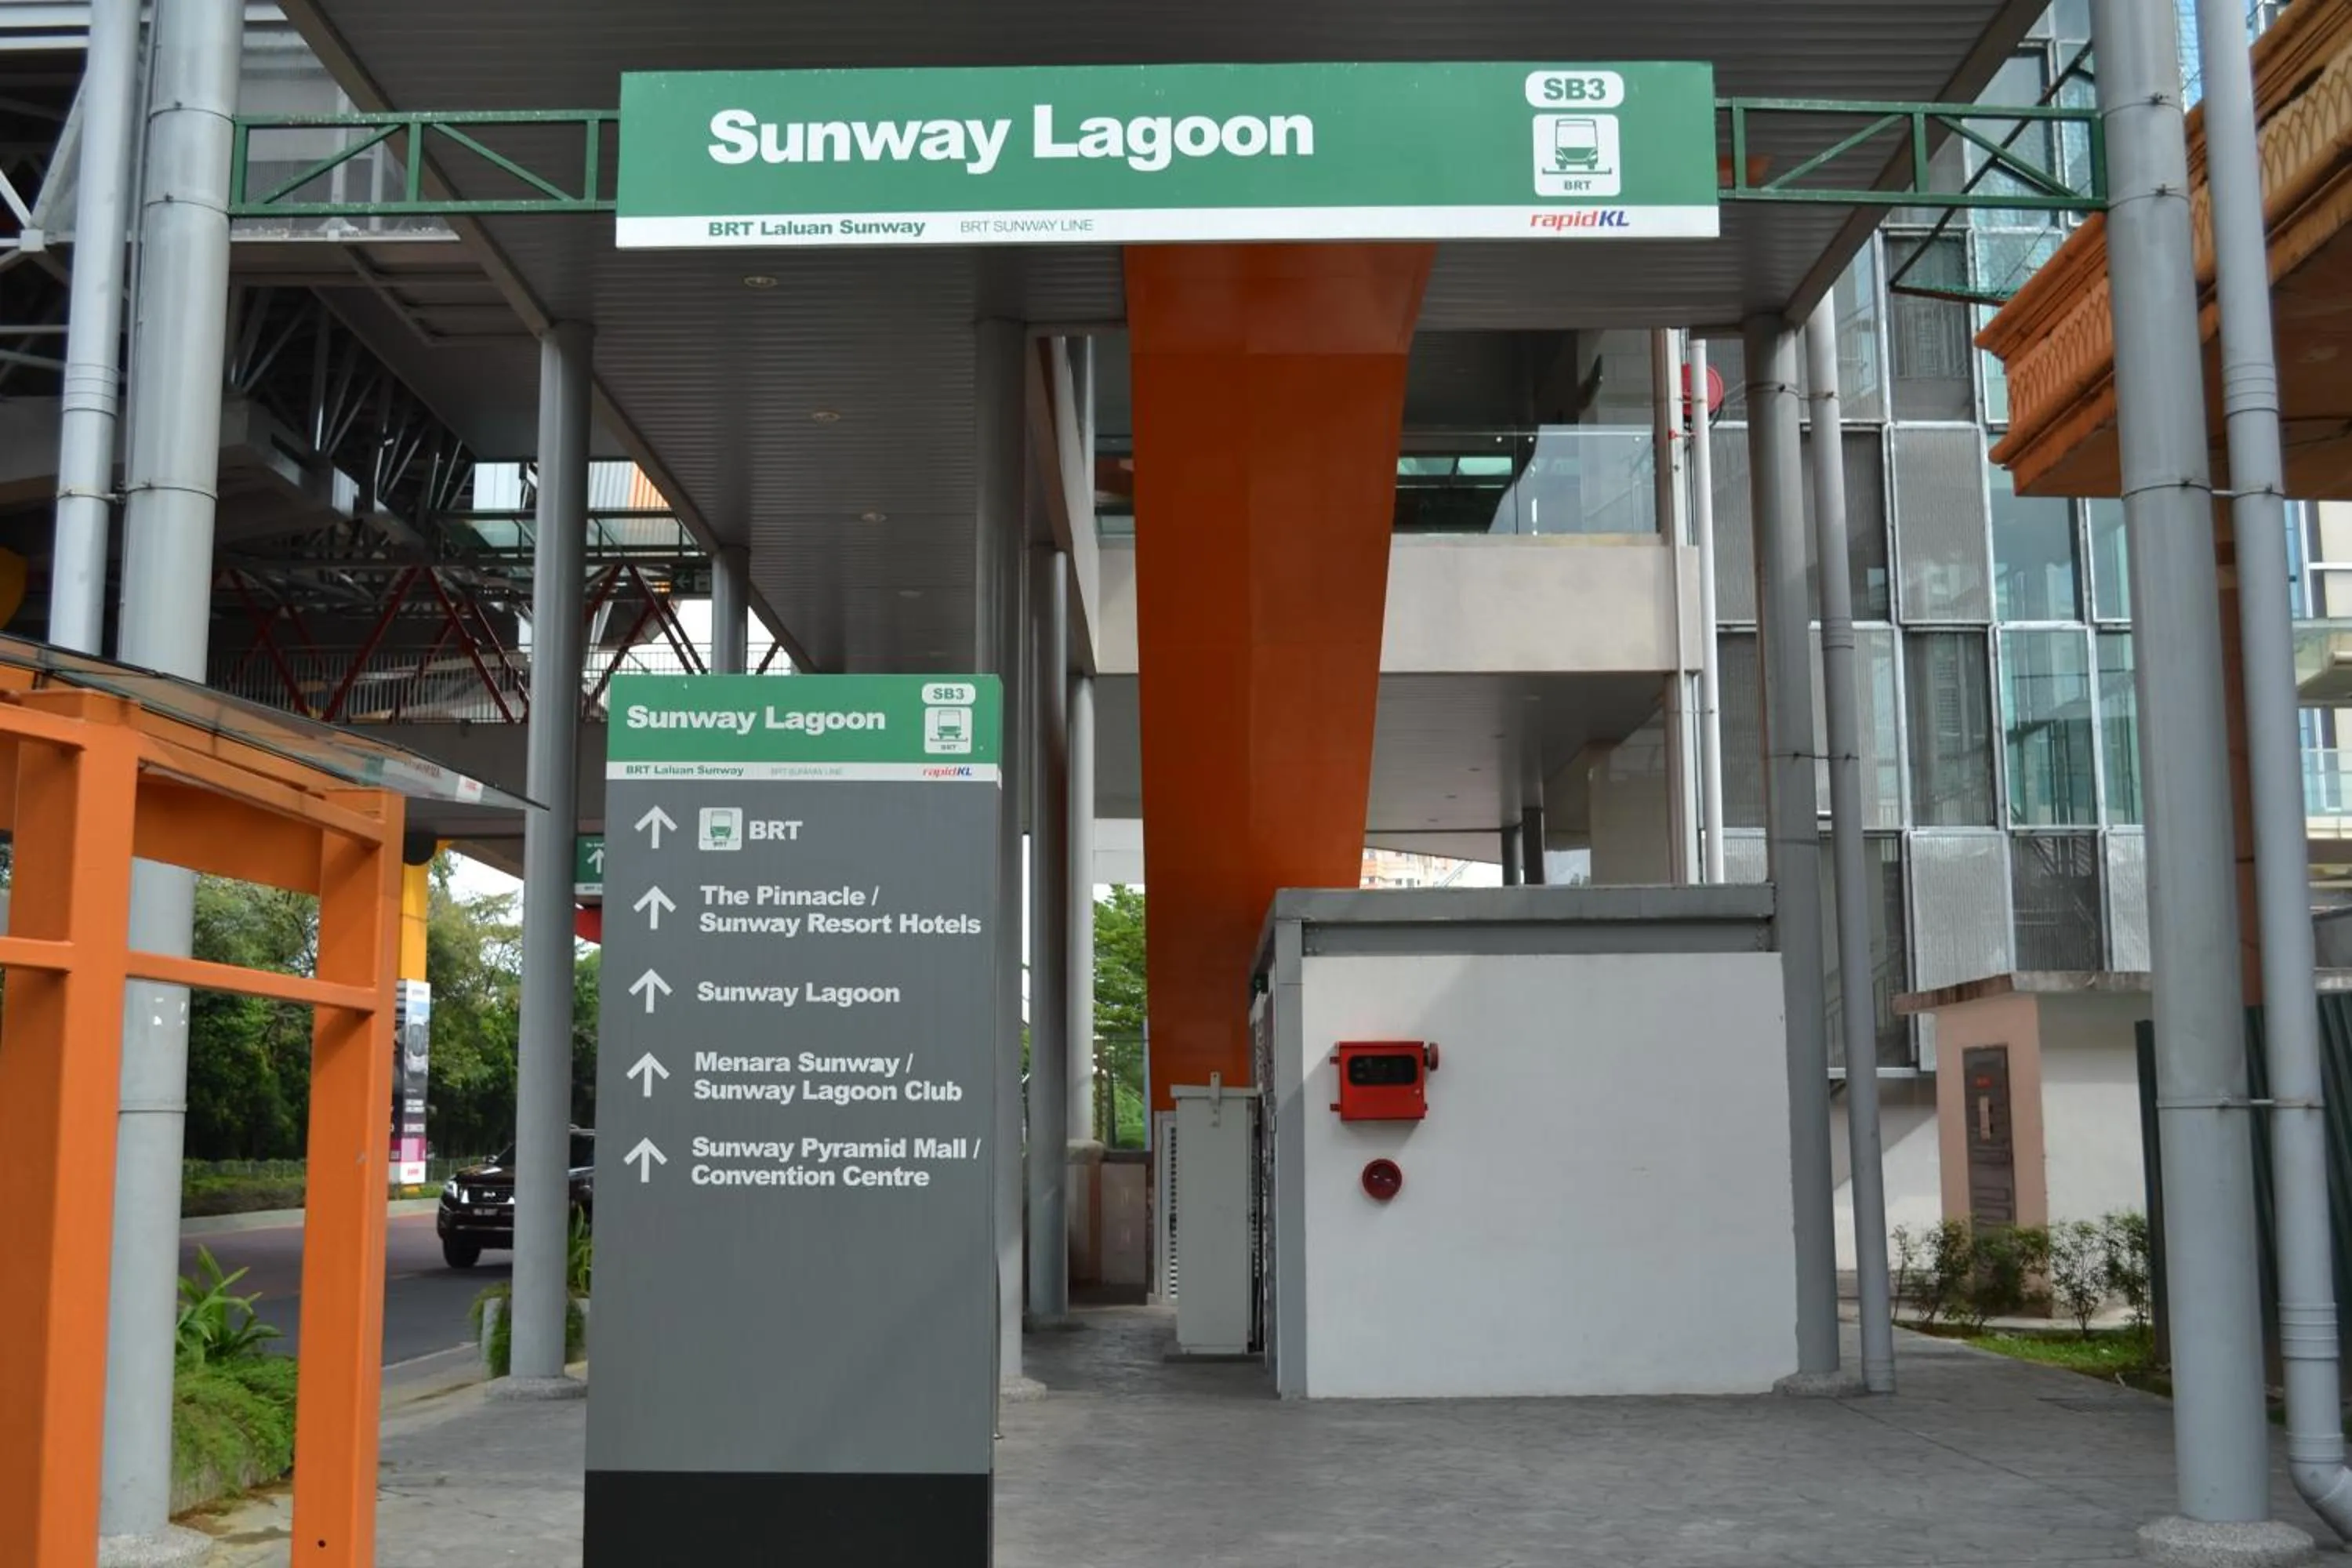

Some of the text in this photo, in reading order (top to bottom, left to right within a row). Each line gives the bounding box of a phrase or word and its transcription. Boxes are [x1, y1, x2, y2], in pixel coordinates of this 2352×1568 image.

[1543, 78, 1606, 101] SB3
[708, 104, 1314, 175] Sunway Lagoon
[1563, 180, 1592, 191] BRT
[707, 219, 926, 238] BRT Laluan Sunway
[960, 220, 1094, 234] BRT SUNWAY LINE
[1530, 210, 1630, 231] rapidKL
[933, 688, 964, 700] SB3
[626, 705, 886, 735] Sunway Lagoon
[626, 765, 744, 777] BRT Laluan Sunway
[923, 766, 972, 778] rapidKL
[749, 820, 803, 840] BRT
[700, 885, 750, 906] The
[757, 886, 866, 906] Pinnacle
[699, 913, 982, 937] Sunway Resort Hotels
[697, 982, 900, 1007] Sunway Lagoon
[695, 1052, 790, 1073] Menara
[797, 1052, 899, 1077] Sunway
[694, 1080, 962, 1105] Sunway Lagoon Club
[691, 1137, 794, 1162] Sunway
[801, 1138, 906, 1163] Pyramid
[913, 1138, 966, 1159] Mall
[691, 1165, 930, 1187] Convention Centre
